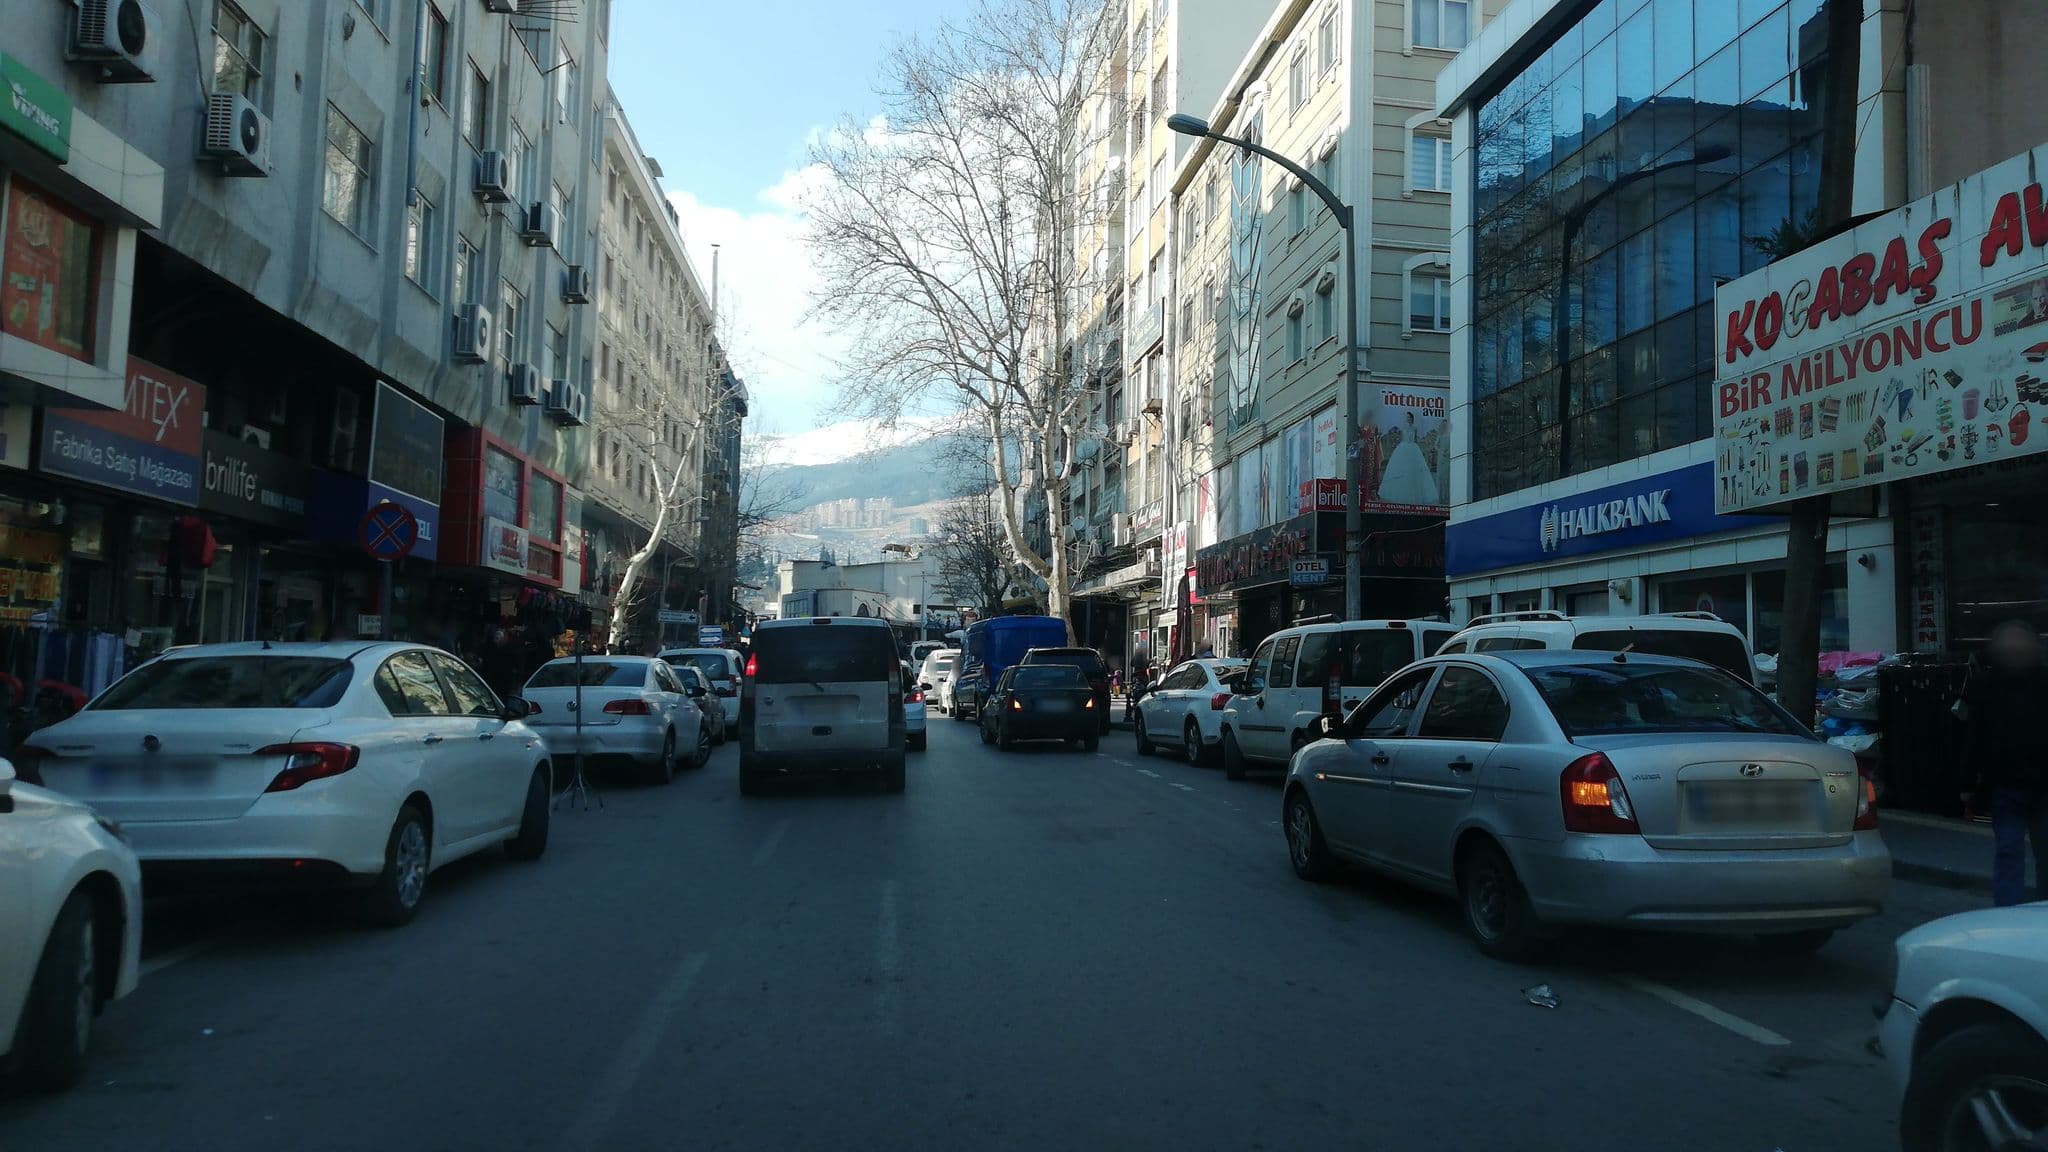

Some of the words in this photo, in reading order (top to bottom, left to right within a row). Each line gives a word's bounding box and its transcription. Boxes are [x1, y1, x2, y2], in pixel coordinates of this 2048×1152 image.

[1726, 217, 1951, 364] KOCABAŞ
[52, 429, 102, 465] Fabrika
[106, 446, 137, 480] Satış
[140, 455, 192, 489] Mağazası
[205, 450, 257, 501] brillife
[1560, 488, 1672, 541] HALKBANK
[1293, 573, 1325, 584] KENT
[1296, 562, 1325, 572] OTEL
